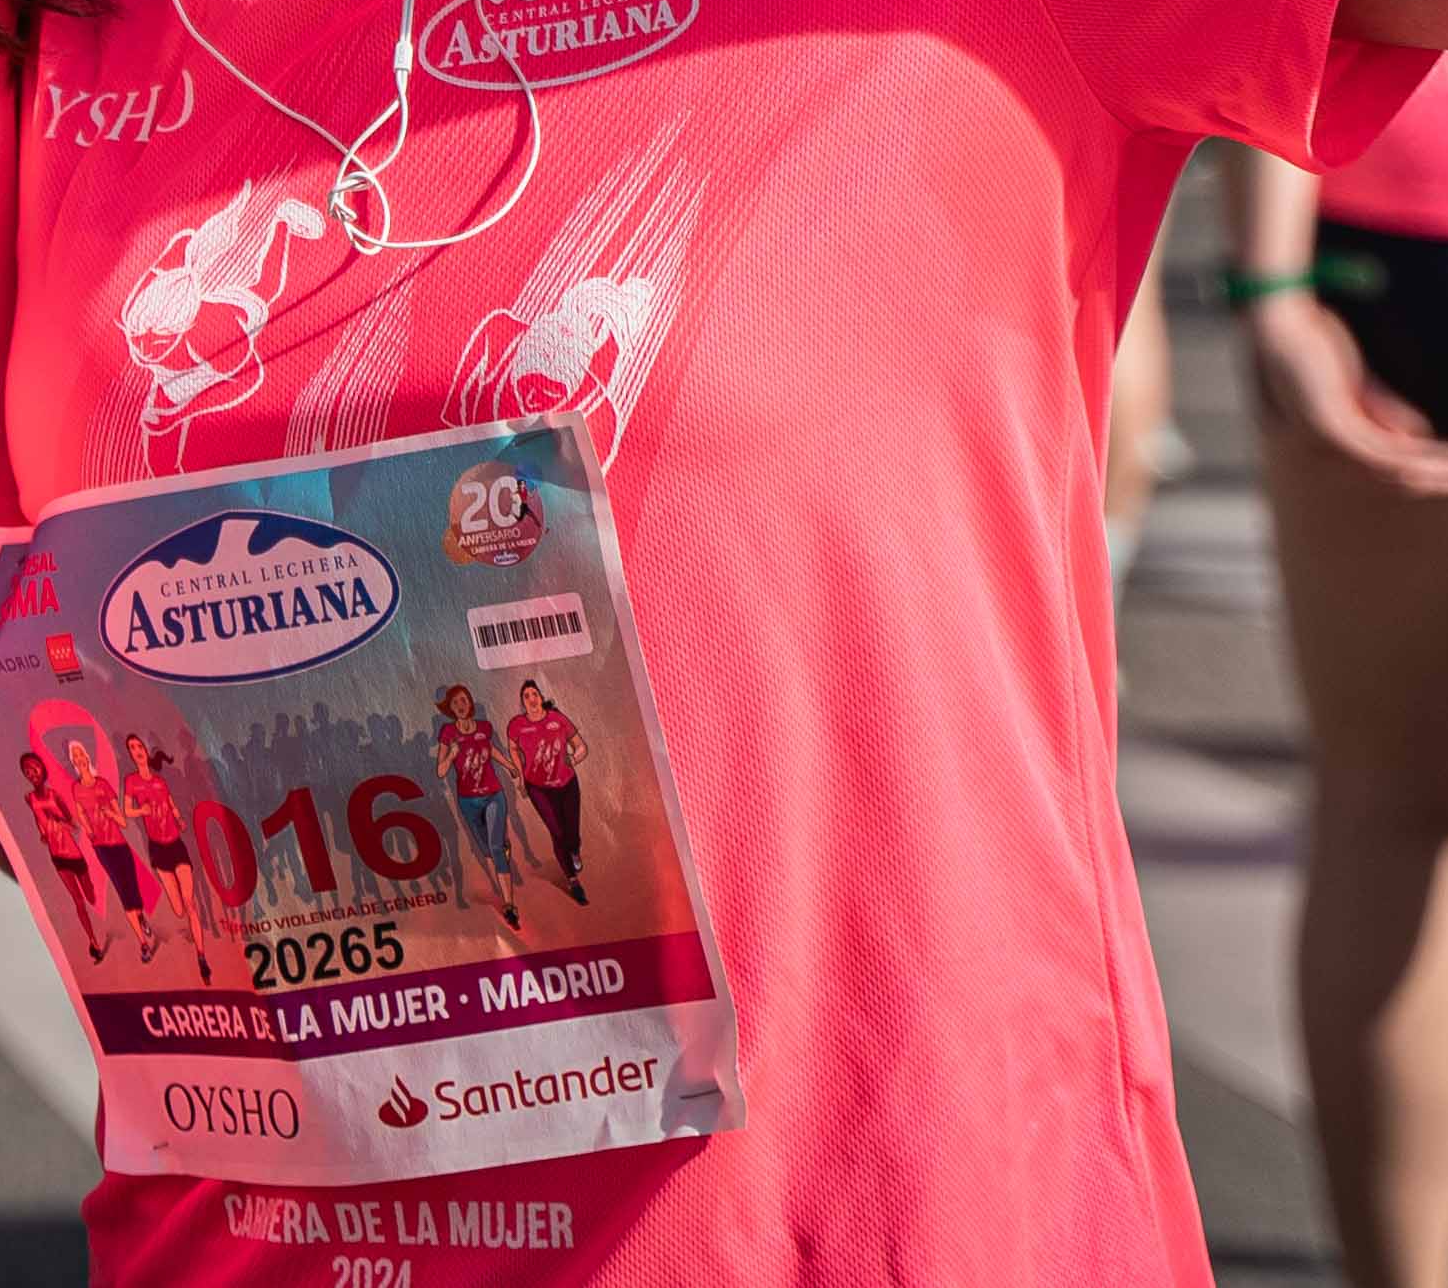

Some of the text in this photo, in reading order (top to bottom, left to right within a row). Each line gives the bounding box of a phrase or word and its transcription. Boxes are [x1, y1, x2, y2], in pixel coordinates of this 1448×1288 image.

[43, 69, 195, 148] YSHO
[160, 552, 359, 598] CENTRAL LECHERA
[124, 576, 381, 654] ASTURIANA
[193, 774, 442, 908] 016
[274, 906, 356, 931] VIOLENCIA
[356, 903, 381, 916] DE
[384, 890, 448, 914] GÉNERO
[244, 921, 404, 991] 20265
[142, 1004, 249, 1041] CARRERA
[276, 1004, 323, 1044] LA
[331, 985, 451, 1036] MUJER
[478, 957, 626, 1015] MADRID
[164, 1082, 301, 1141] OYSHO
[434, 1056, 659, 1122] Santander
[334, 1201, 386, 1245] DE
[393, 1200, 440, 1247] LA
[447, 1200, 575, 1250] MUJER
